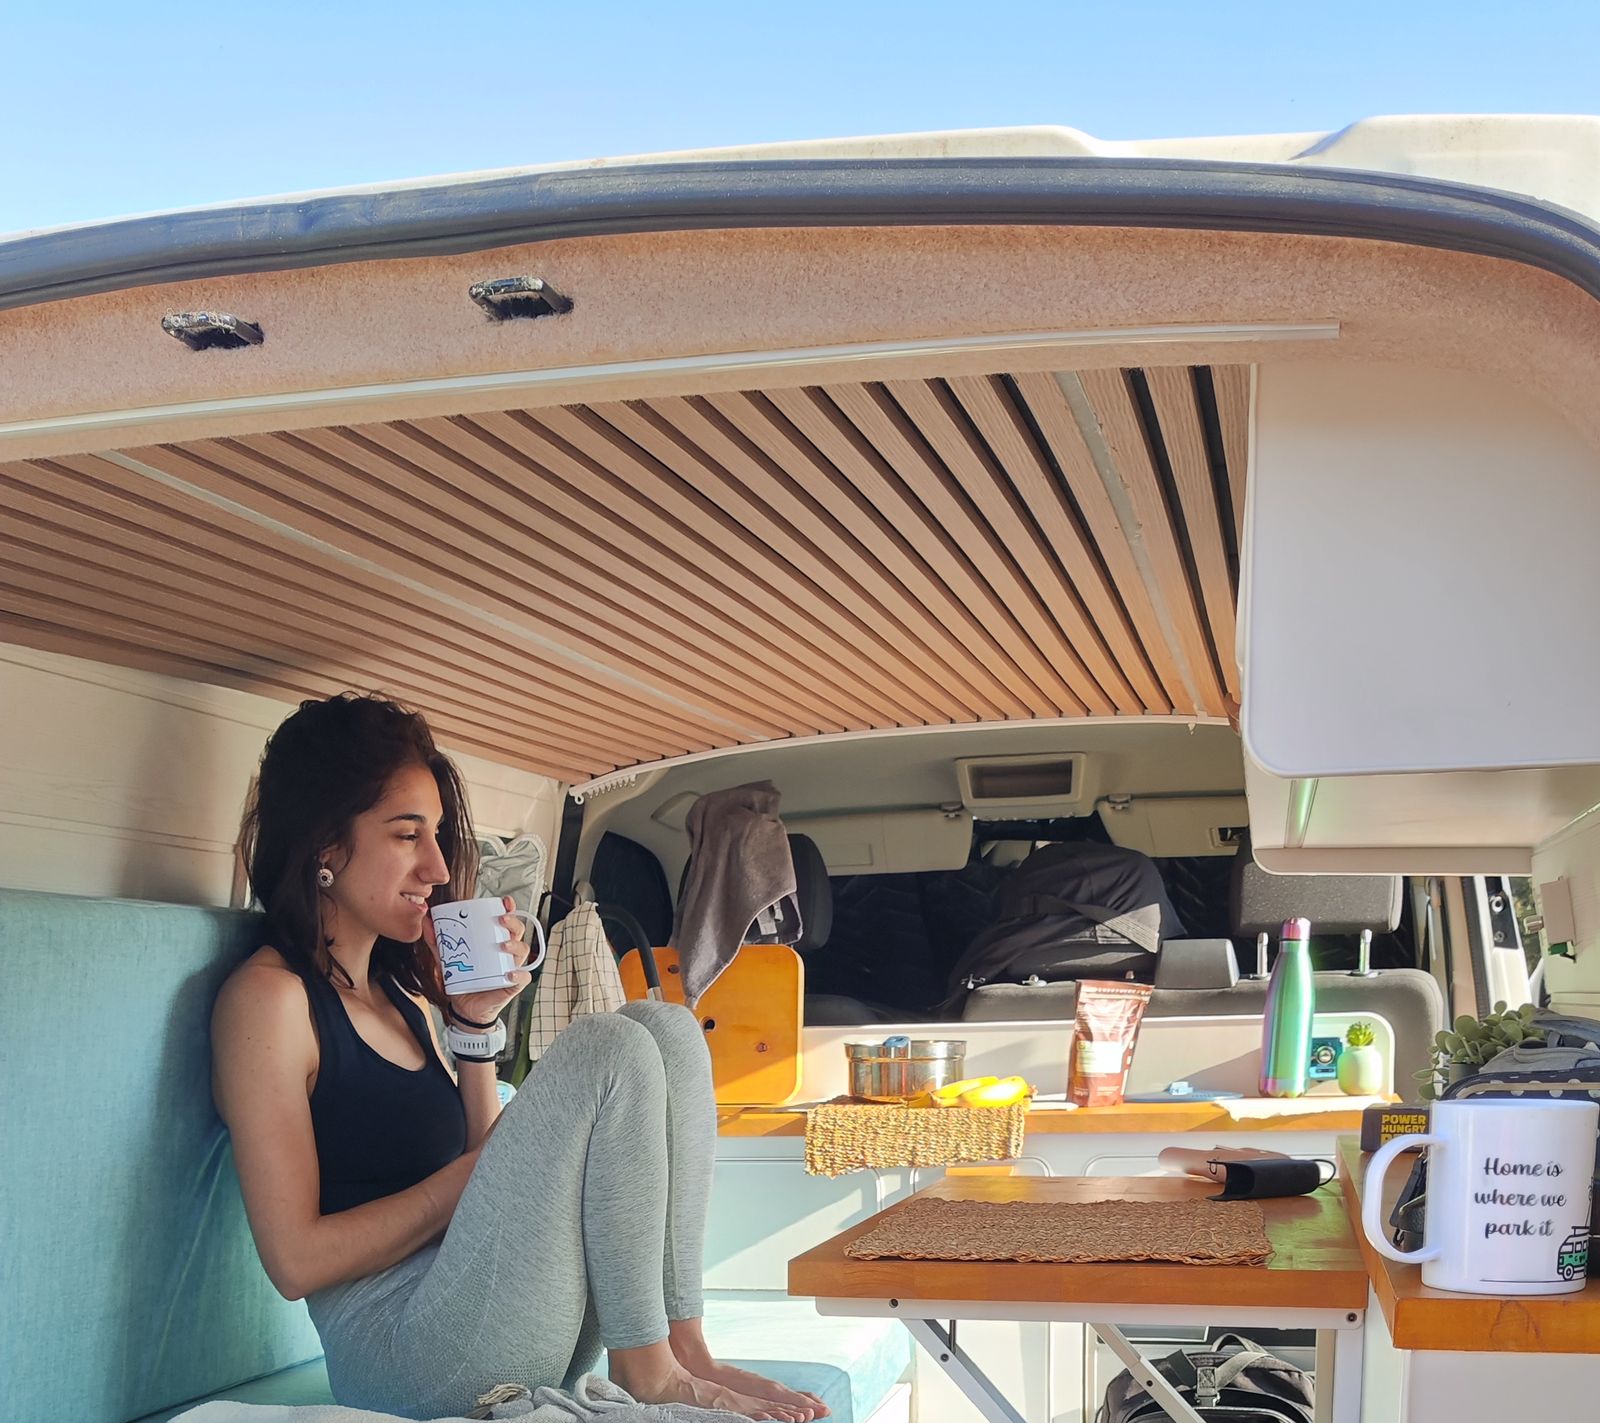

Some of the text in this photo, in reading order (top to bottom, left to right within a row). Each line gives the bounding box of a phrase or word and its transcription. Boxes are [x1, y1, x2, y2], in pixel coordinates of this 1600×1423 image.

[1381, 1124, 1426, 1133] HUNGRY
[1382, 1114, 1427, 1125] POWER
[1483, 1157, 1563, 1177] Home is
[1474, 1189, 1567, 1207] where we
[1484, 1219, 1554, 1239] park it
